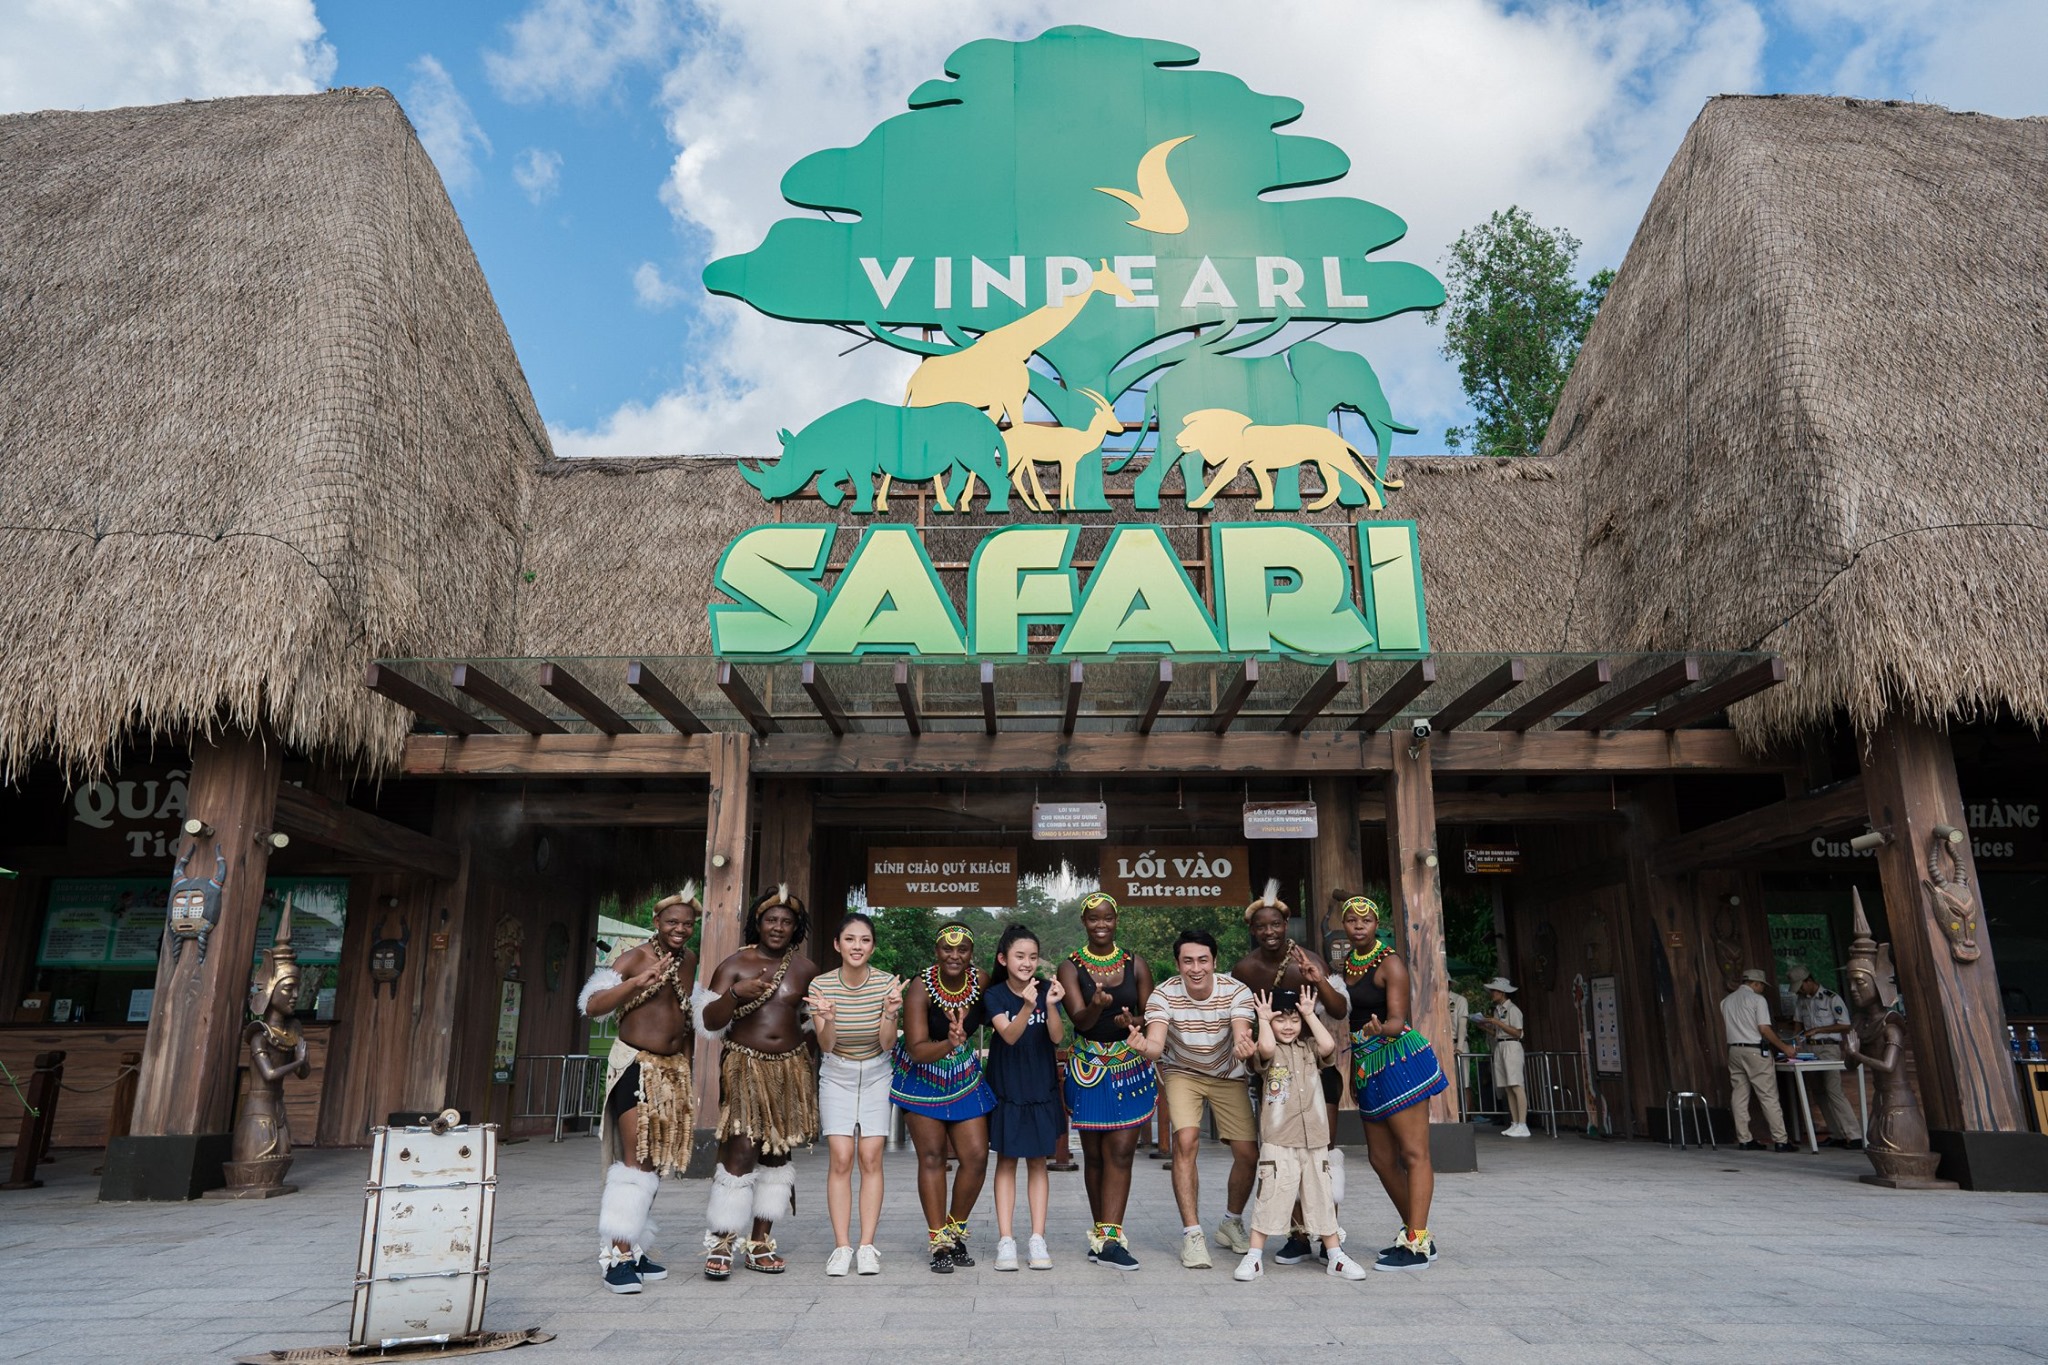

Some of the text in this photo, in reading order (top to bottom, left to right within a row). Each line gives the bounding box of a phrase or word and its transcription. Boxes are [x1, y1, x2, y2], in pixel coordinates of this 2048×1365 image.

[859, 255, 1369, 309] VINPEARL
[710, 522, 1428, 660] SAFARI
[1968, 798, 2040, 828] HÀNG
[874, 859, 1011, 876] KÍNH CHÀO QUÝ KHÁCH
[1117, 849, 1233, 878] LỐI VÀO
[906, 882, 980, 893] WELCOME
[1127, 882, 1222, 897] Entrance
